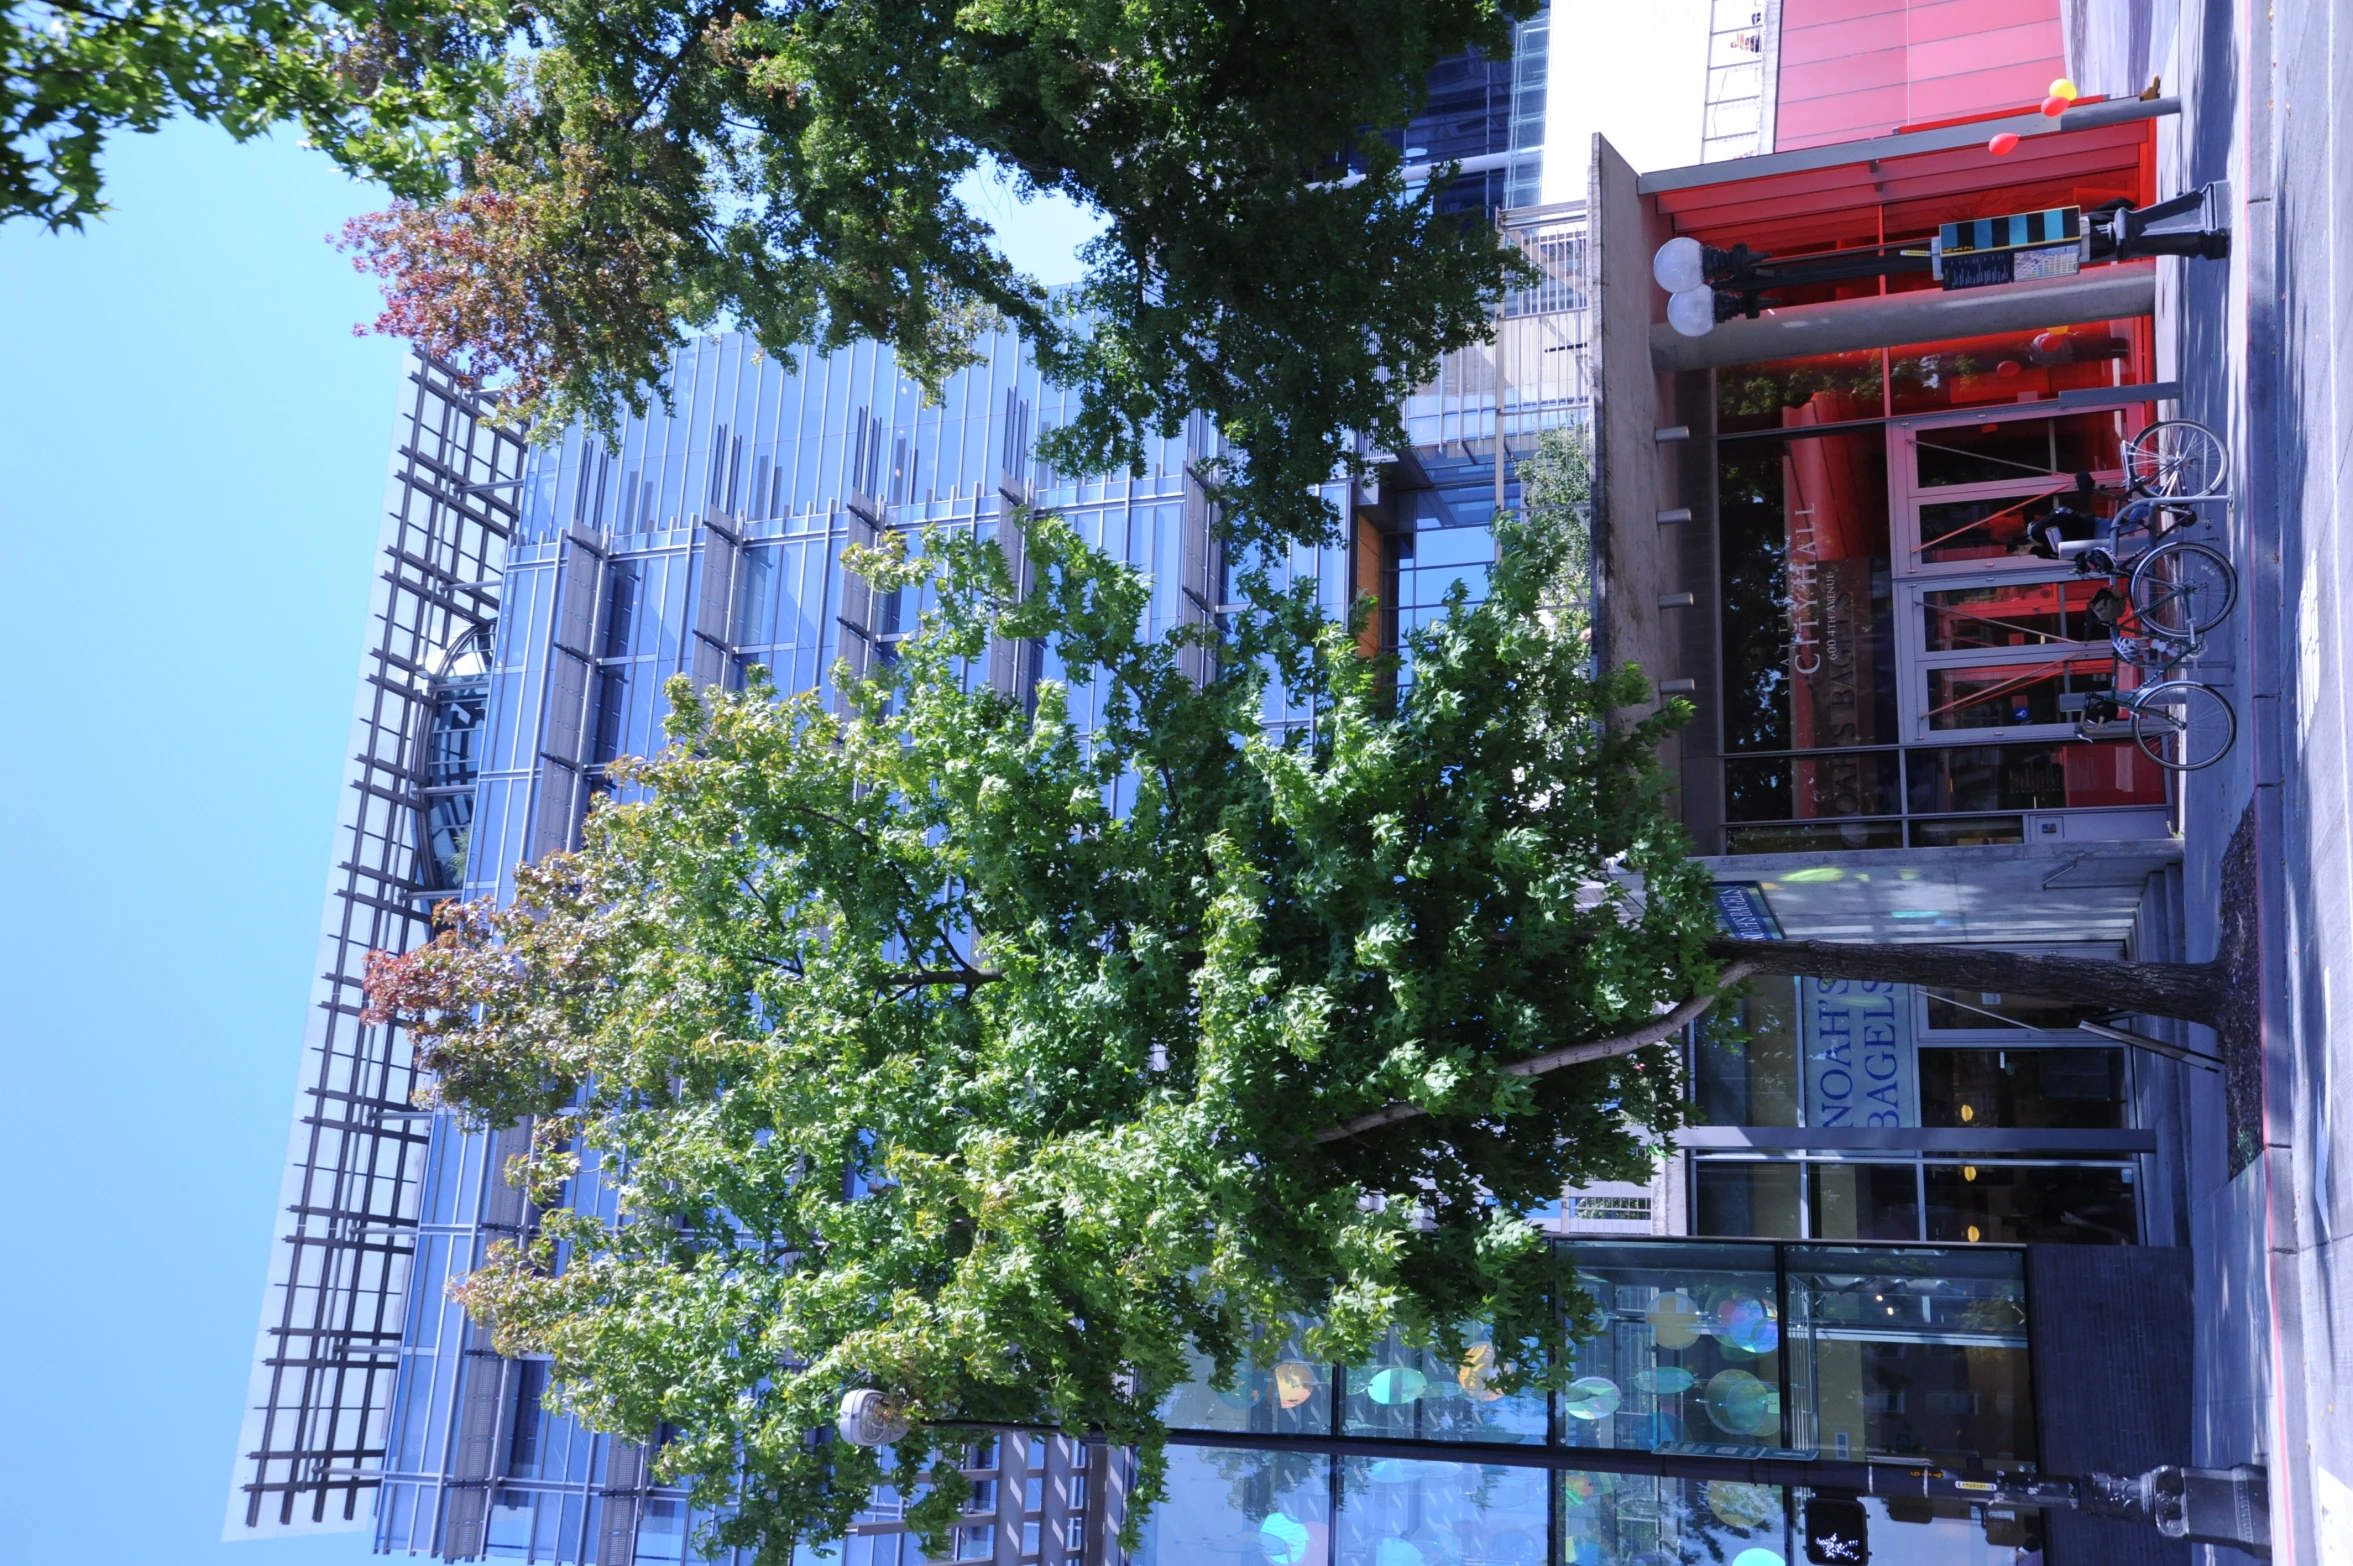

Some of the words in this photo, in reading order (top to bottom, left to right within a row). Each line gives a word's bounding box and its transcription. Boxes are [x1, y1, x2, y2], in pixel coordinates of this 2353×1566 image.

[1793, 503, 1818, 585] HALL
[1824, 572, 1836, 612] AVENUE
[1826, 616, 1837, 637] 4TH
[1777, 596, 1791, 696] SEATTLE
[1794, 597, 1821, 674] CITY
[1826, 639, 1838, 660] 600
[1830, 723, 1859, 813] OAH'S
[1719, 889, 1753, 916] BAGELS
[1732, 917, 1767, 940] NOAH'S
[1816, 978, 1853, 1128] NOAH'S
[1861, 981, 1900, 1128] BAGELS
